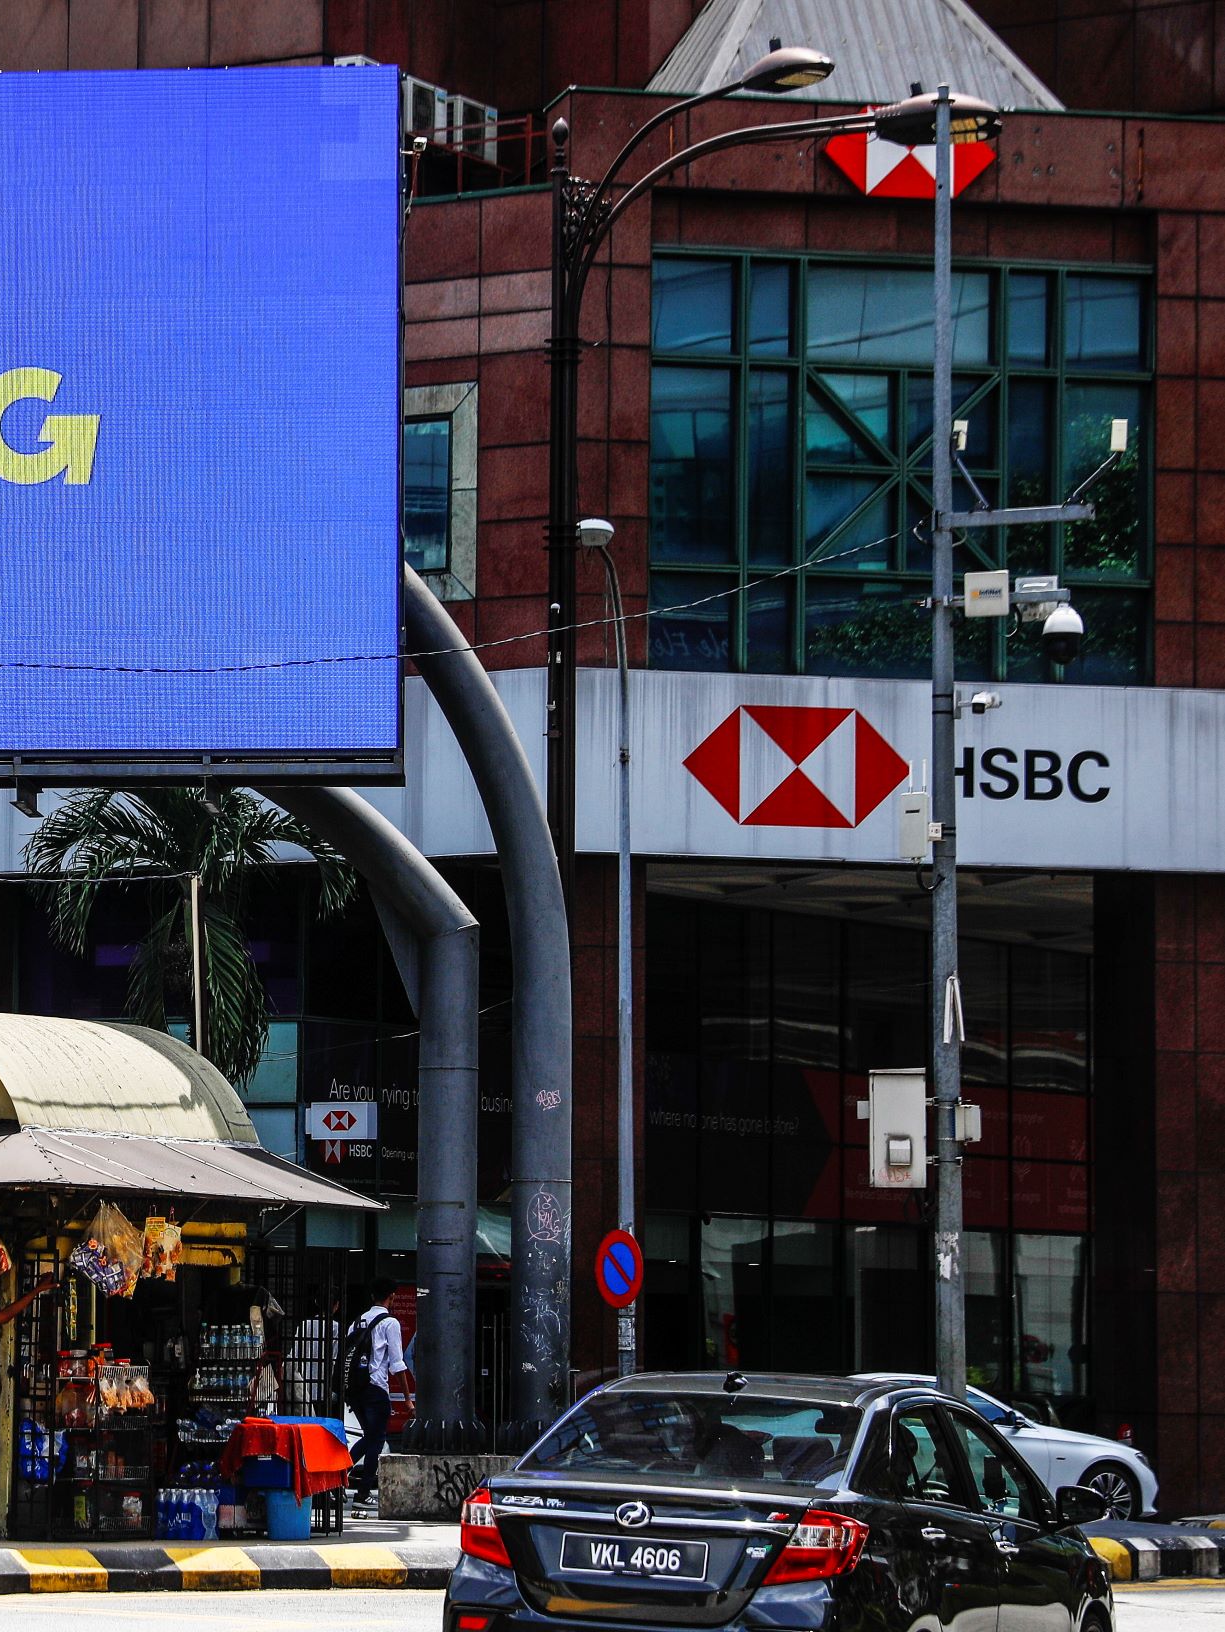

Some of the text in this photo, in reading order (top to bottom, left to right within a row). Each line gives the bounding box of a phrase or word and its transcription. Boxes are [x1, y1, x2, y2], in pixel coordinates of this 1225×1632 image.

[329, 1078, 350, 1100] Are
[353, 1083, 374, 1102] you
[382, 1083, 410, 1110] rying
[348, 1145, 373, 1159] HSBC
[381, 1146, 407, 1162] Opening
[590, 1542, 681, 1570] VKL 4606
